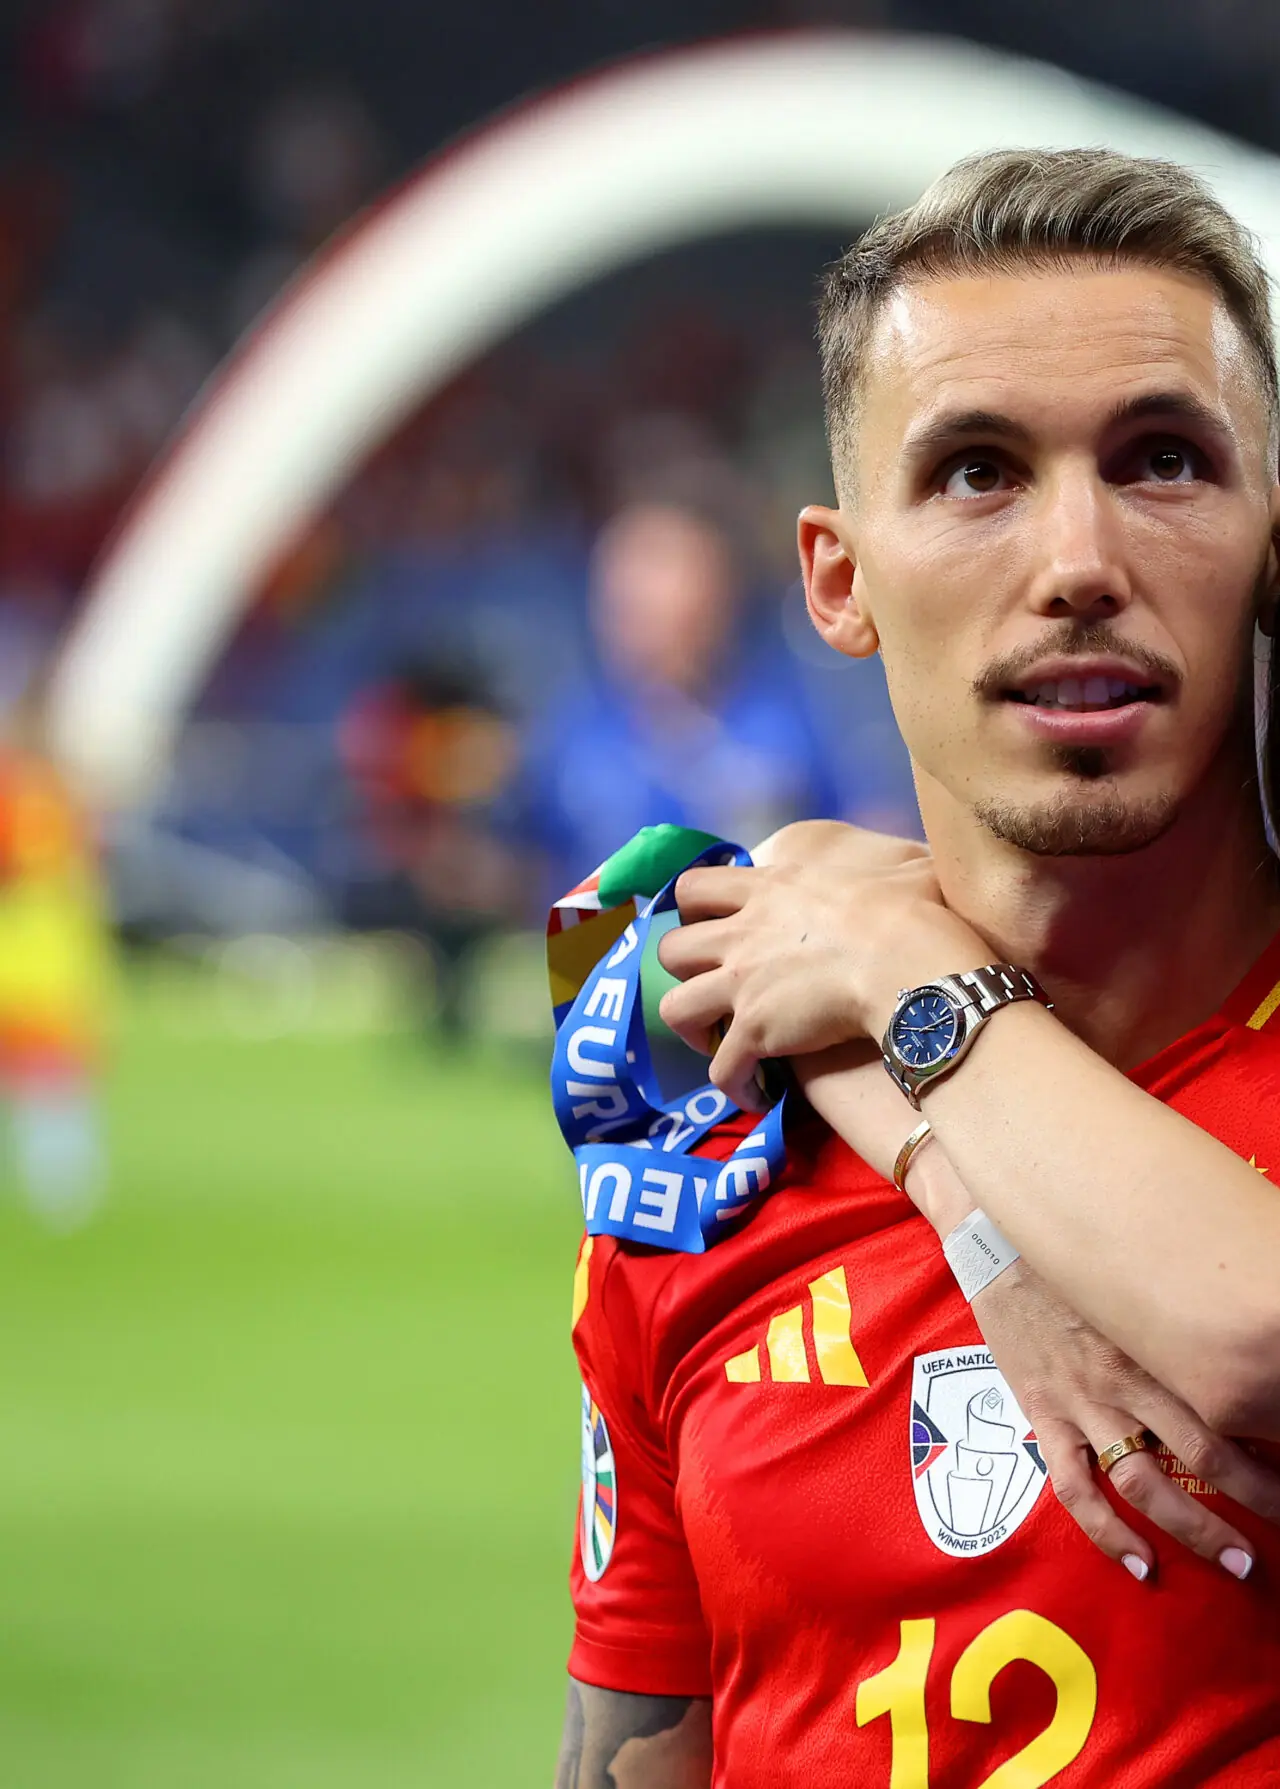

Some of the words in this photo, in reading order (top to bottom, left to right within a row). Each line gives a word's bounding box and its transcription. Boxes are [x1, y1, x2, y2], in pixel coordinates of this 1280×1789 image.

[579, 1163, 684, 1232] EU
[971, 1233, 1000, 1265] 000010
[922, 1358, 954, 1375] UEFA
[937, 1528, 978, 1550] WINNER
[981, 1525, 1008, 1547] 2023
[855, 1608, 1097, 1789] 12
